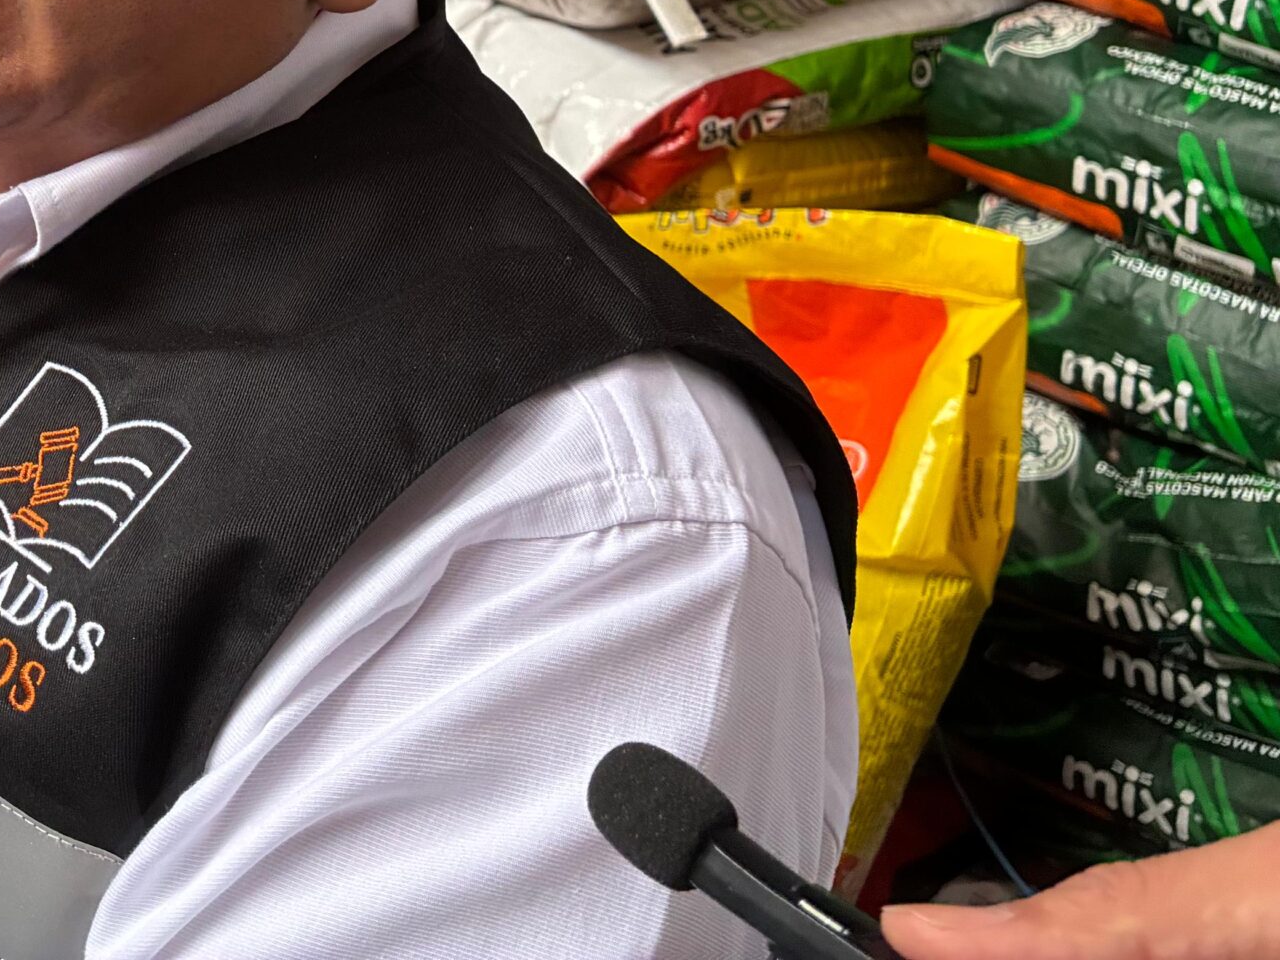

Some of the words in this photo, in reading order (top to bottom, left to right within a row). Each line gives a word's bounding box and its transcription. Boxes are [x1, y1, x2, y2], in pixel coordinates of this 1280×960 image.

[1072, 155, 1204, 234] mixi
[1111, 250, 1168, 281] OFICIAL
[1170, 271, 1258, 314] MASCOTAS
[1061, 349, 1193, 431] mixi
[1146, 481, 1228, 499] MASCOTAS
[1232, 487, 1274, 503] PARA
[1086, 580, 1210, 644] mixi
[1103, 645, 1231, 722] mixi
[1173, 718, 1258, 753] MASCOTAS
[1062, 755, 1195, 840] mixi
